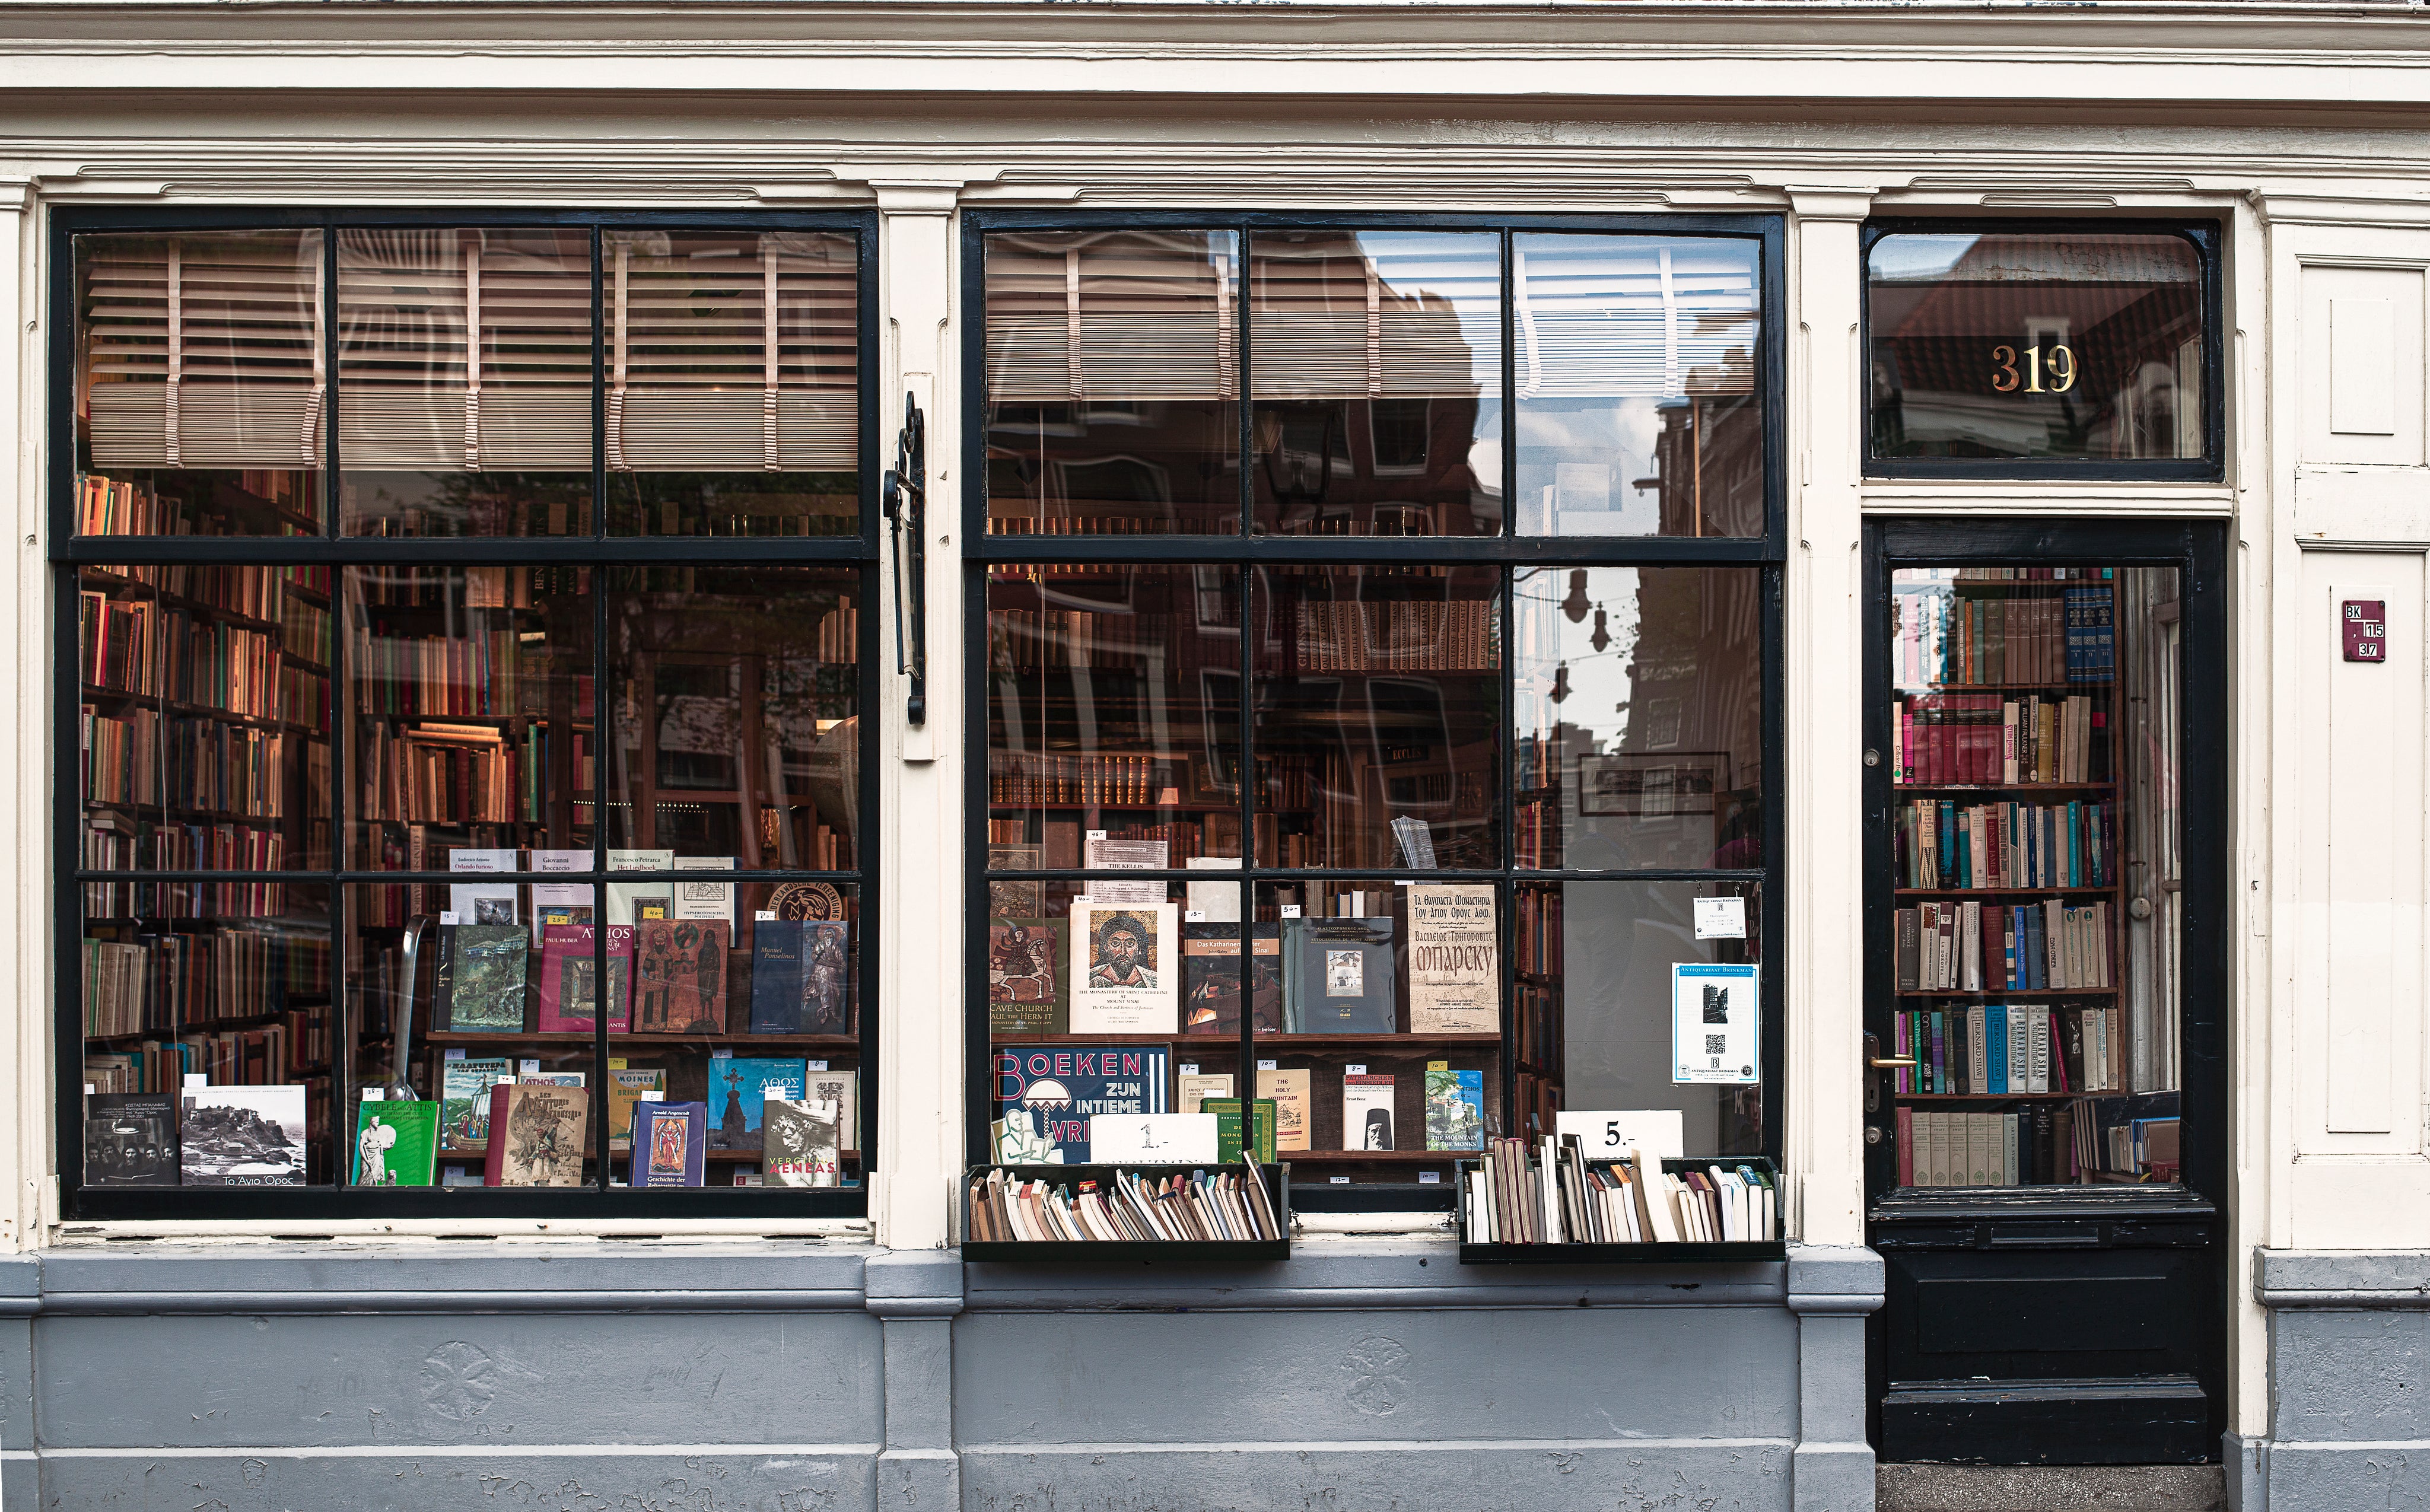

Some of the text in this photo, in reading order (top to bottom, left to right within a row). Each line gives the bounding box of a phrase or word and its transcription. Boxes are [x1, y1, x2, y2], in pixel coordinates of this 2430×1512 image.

[1993, 345, 2078, 393] 319
[2346, 606, 2361, 618] BK
[1297, 602, 1307, 667] GLOSSAIRE
[1490, 607, 1499, 661] BAYEUX
[2368, 625, 2384, 638] 1,5
[2360, 644, 2377, 657] 3,7
[1014, 1004, 1052, 1012] CHURCH
[2017, 1021, 2025, 1079] BERNARD SHAW
[2038, 1023, 2046, 1079] BERNARD SHAW
[759, 1078, 799, 1088] ΑΘΩΣ
[994, 1053, 1140, 1100] BOEKEN
[1106, 1083, 1141, 1097] ZIJN
[1076, 1100, 1141, 1114] INTIEME
[1605, 1121, 1635, 1146] 5.-
[769, 1163, 835, 1173] AENEAS
[223, 1176, 235, 1186] Το
